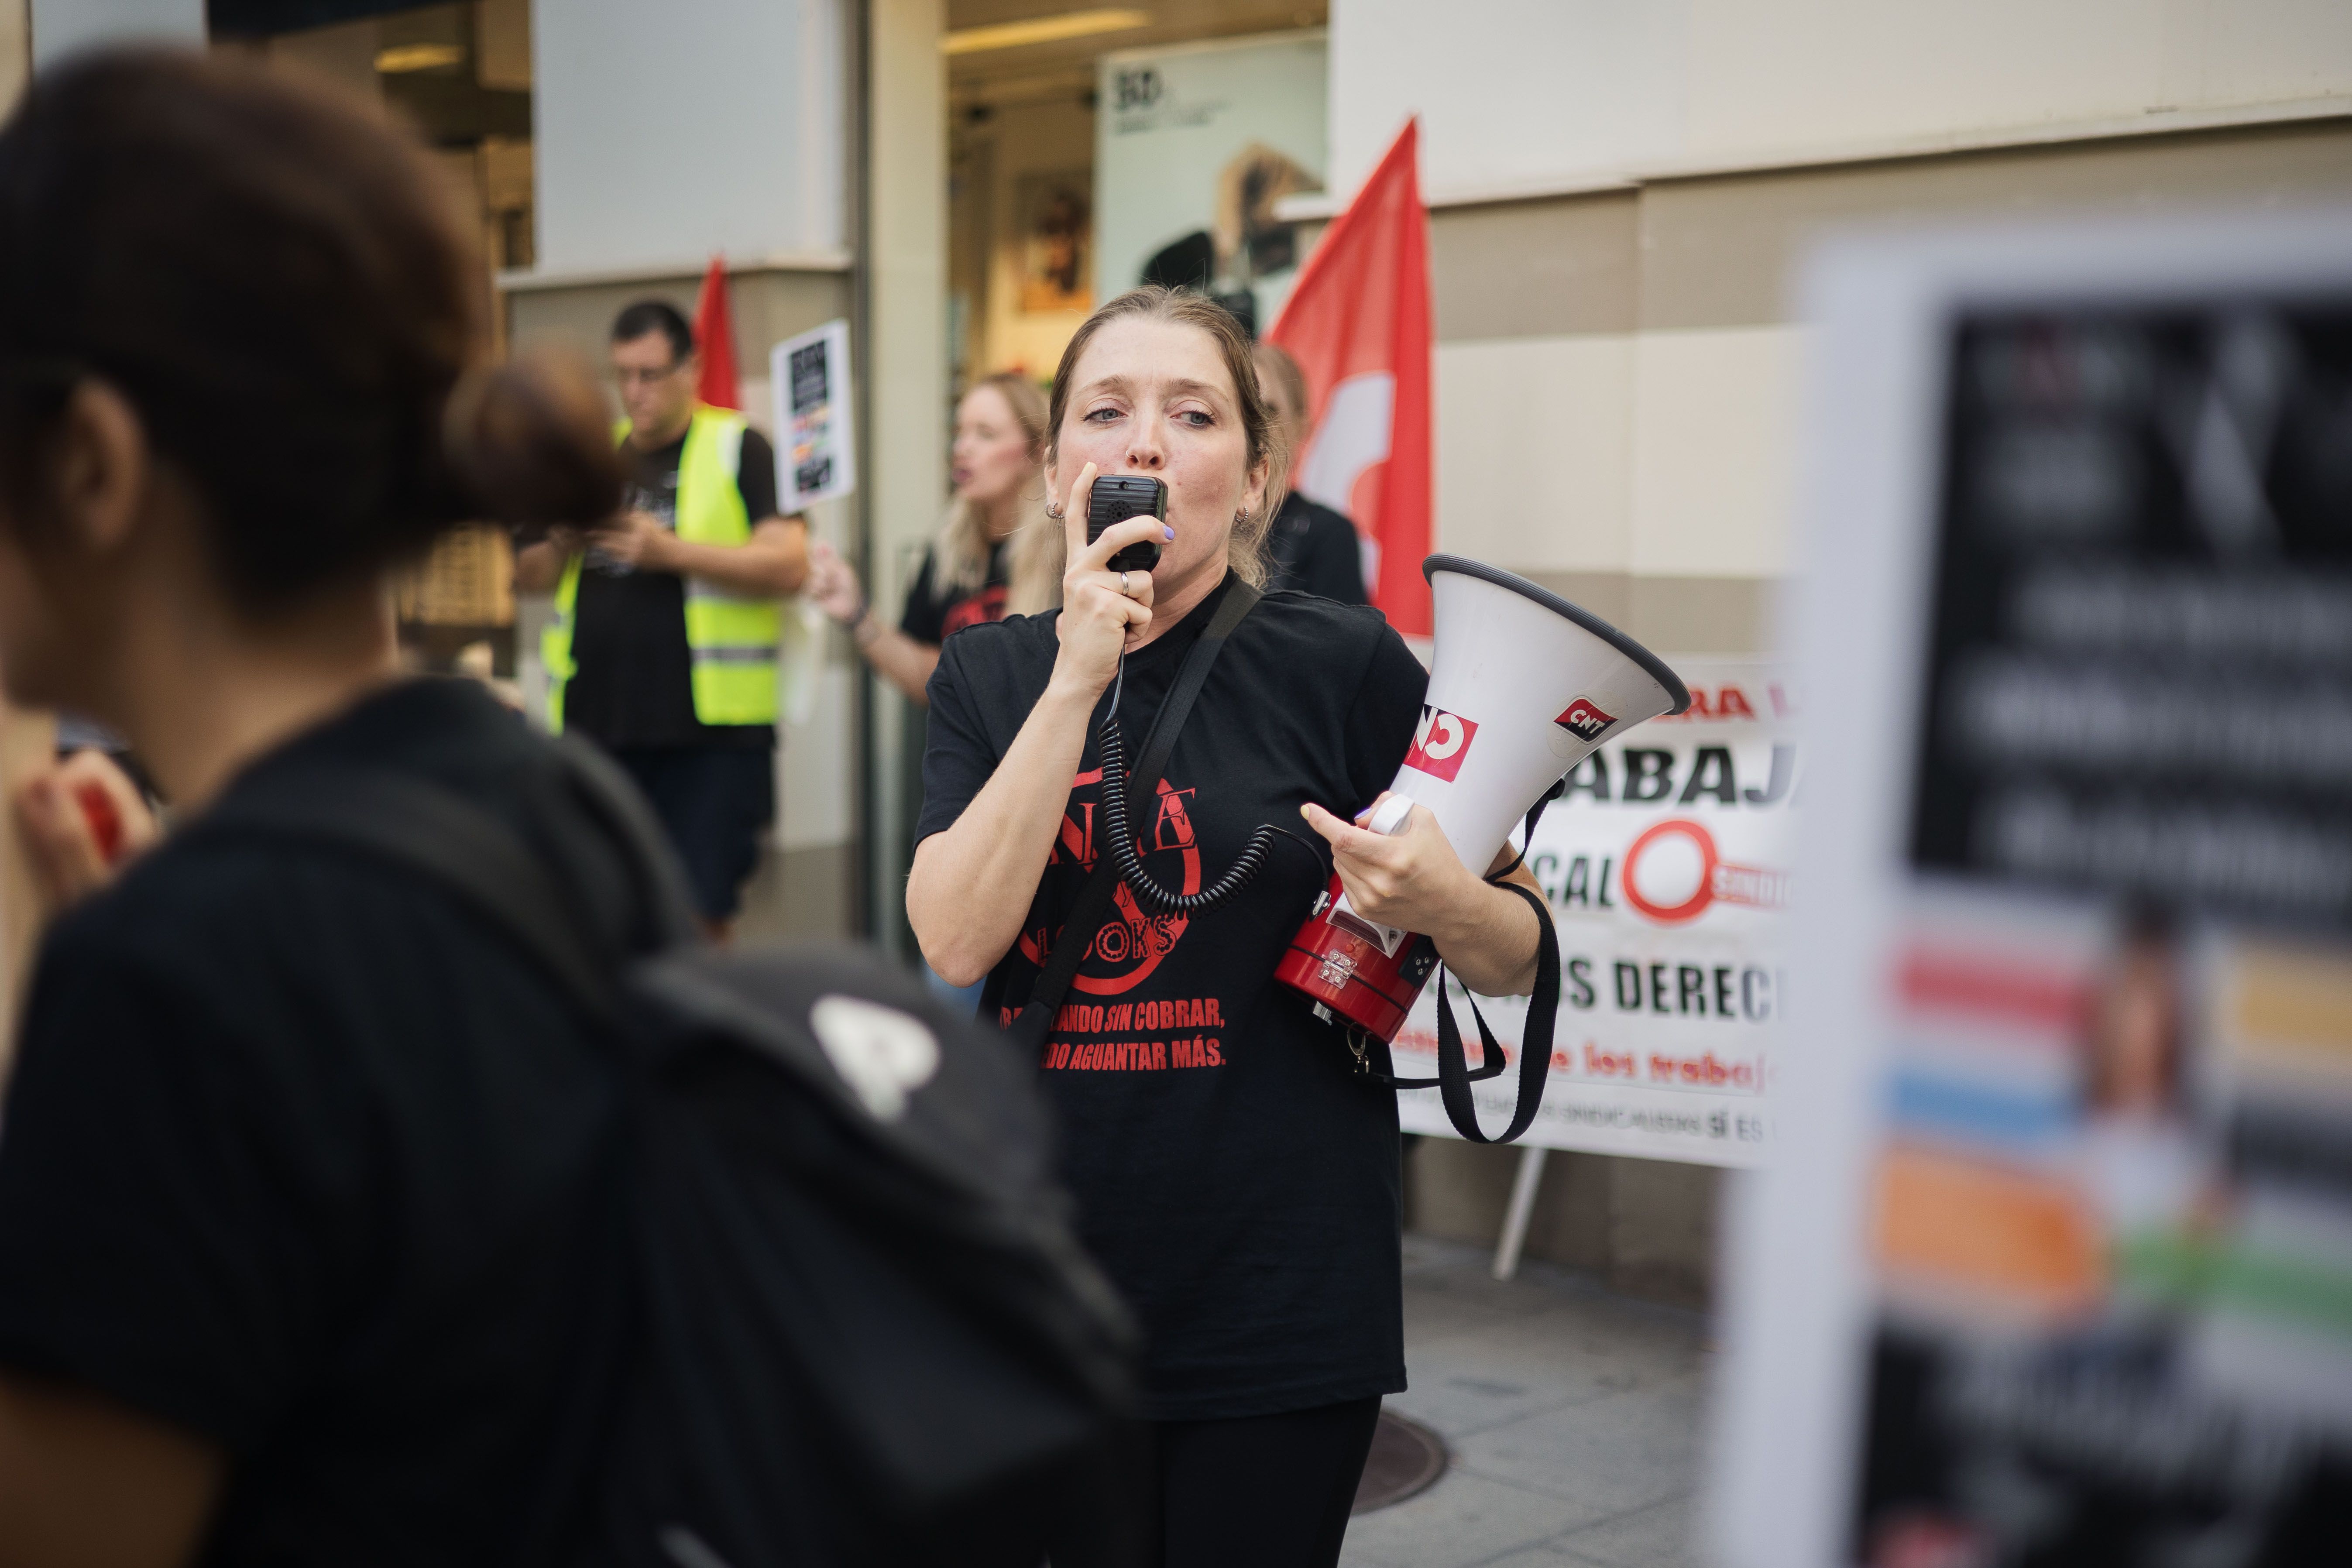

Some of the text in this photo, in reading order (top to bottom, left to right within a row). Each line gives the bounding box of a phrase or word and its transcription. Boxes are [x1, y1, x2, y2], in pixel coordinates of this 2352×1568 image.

[1570, 709, 1606, 734] CNT
[1557, 742, 1797, 807] ABAJ
[1615, 961, 1782, 1025] DEREC
[1105, 1004, 1133, 1032] SIN
[1135, 998, 1225, 1031] COBRAR,
[1069, 1042, 1166, 1071] AGUANTAR
[1171, 1034, 1226, 1068] MÁS.
